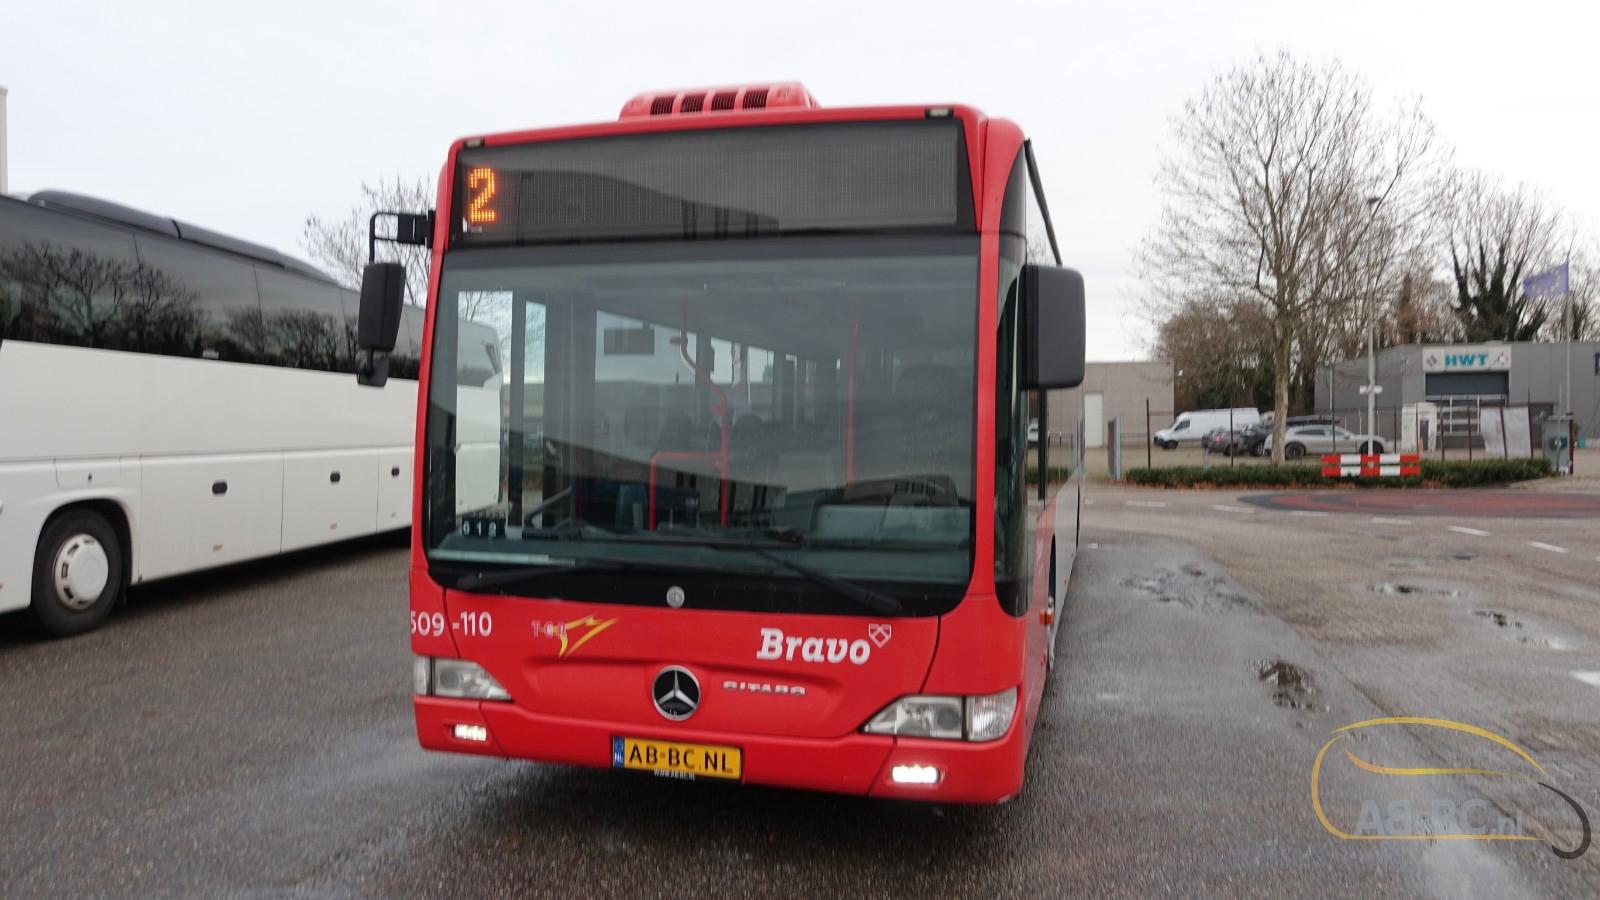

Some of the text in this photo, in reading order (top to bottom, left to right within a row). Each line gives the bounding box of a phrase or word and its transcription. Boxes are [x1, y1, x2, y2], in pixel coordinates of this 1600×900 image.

[469, 167, 496, 223] 2
[1443, 352, 1489, 367] HWT
[756, 627, 871, 665] Bravo
